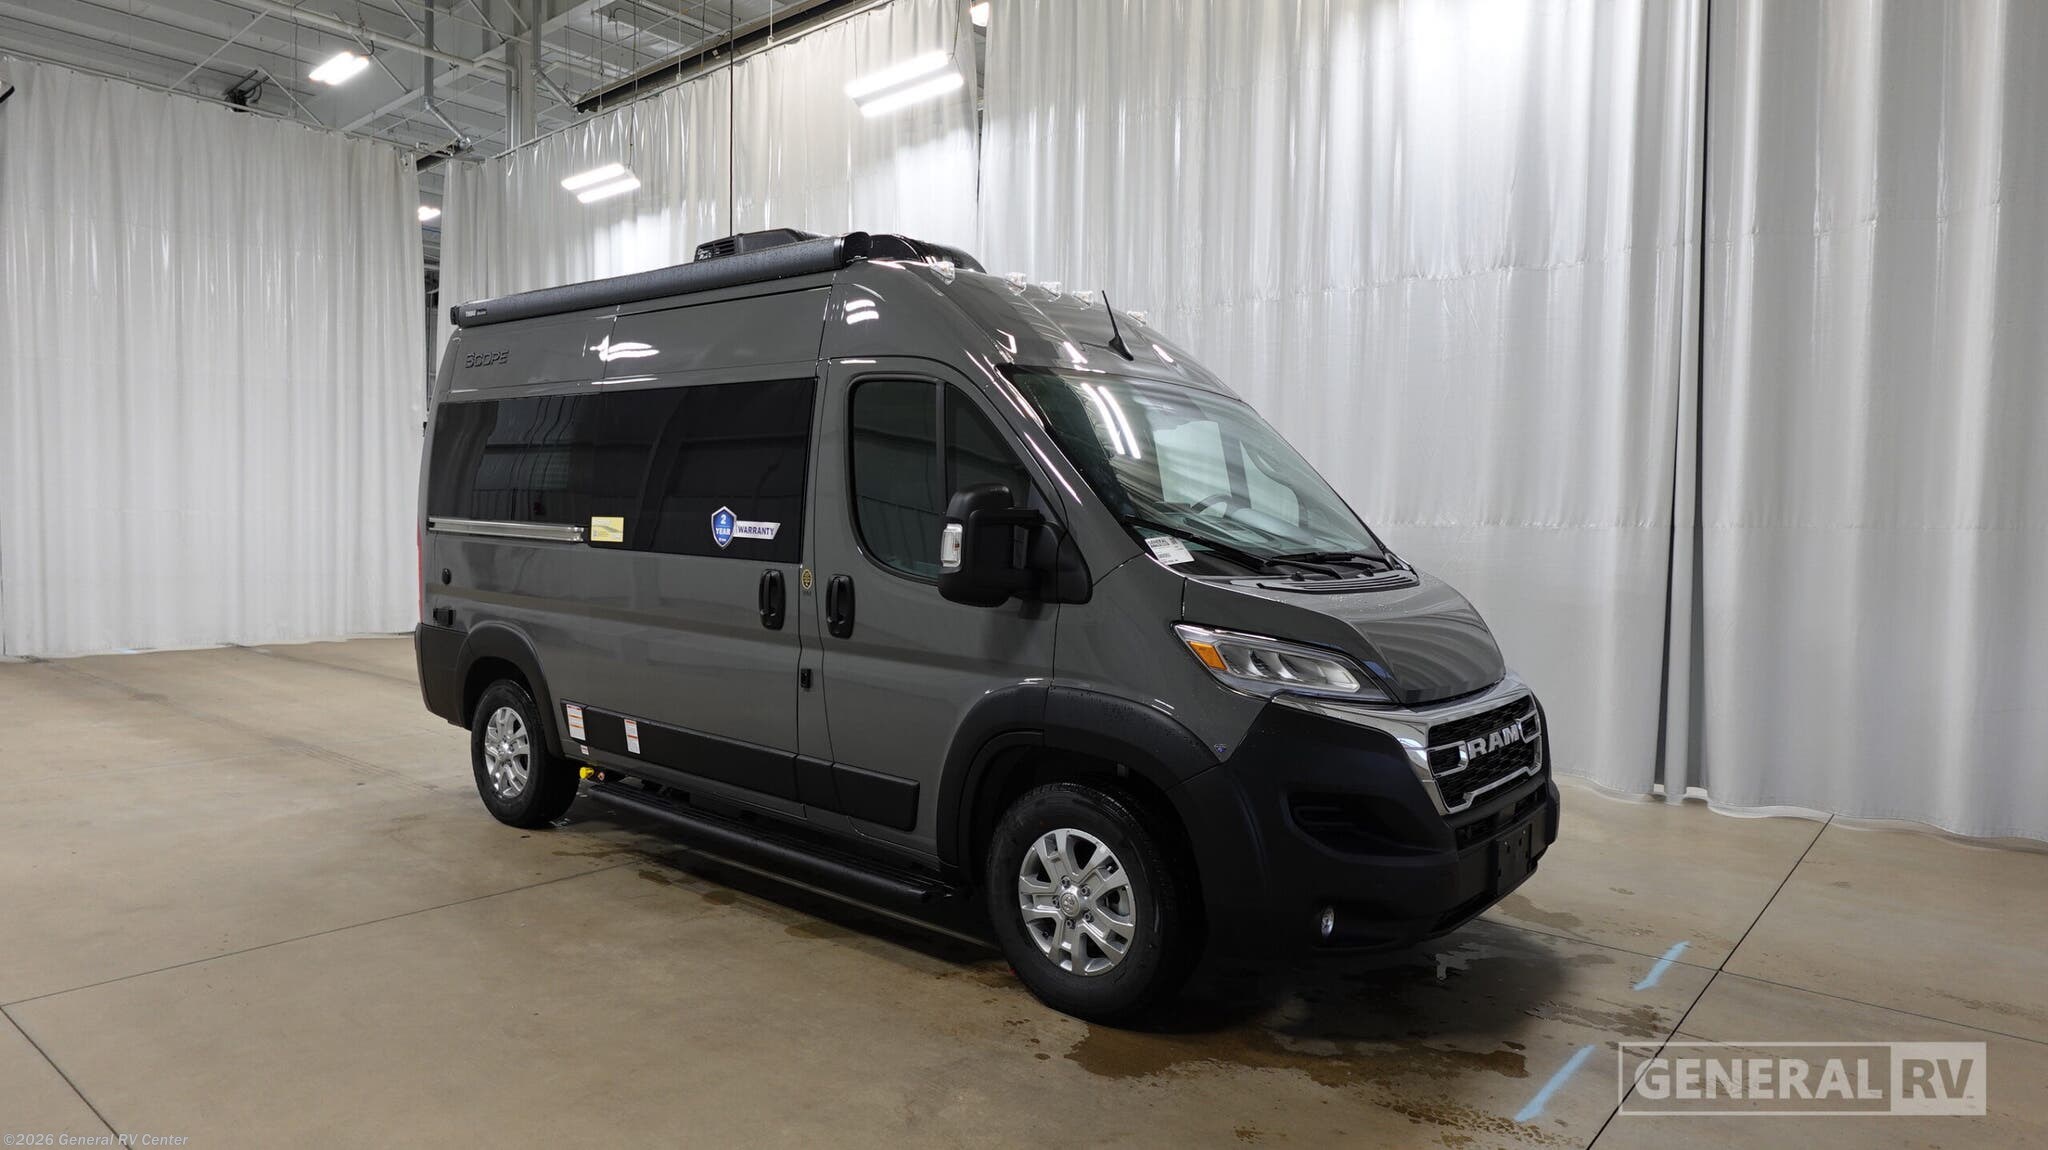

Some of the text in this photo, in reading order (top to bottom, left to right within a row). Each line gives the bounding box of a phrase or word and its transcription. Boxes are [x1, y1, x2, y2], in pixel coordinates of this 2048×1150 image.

[720, 514, 727, 525] 2
[715, 527, 731, 536] YEAR
[738, 526, 775, 536] WARRANTY
[1467, 723, 1520, 761] RAM
